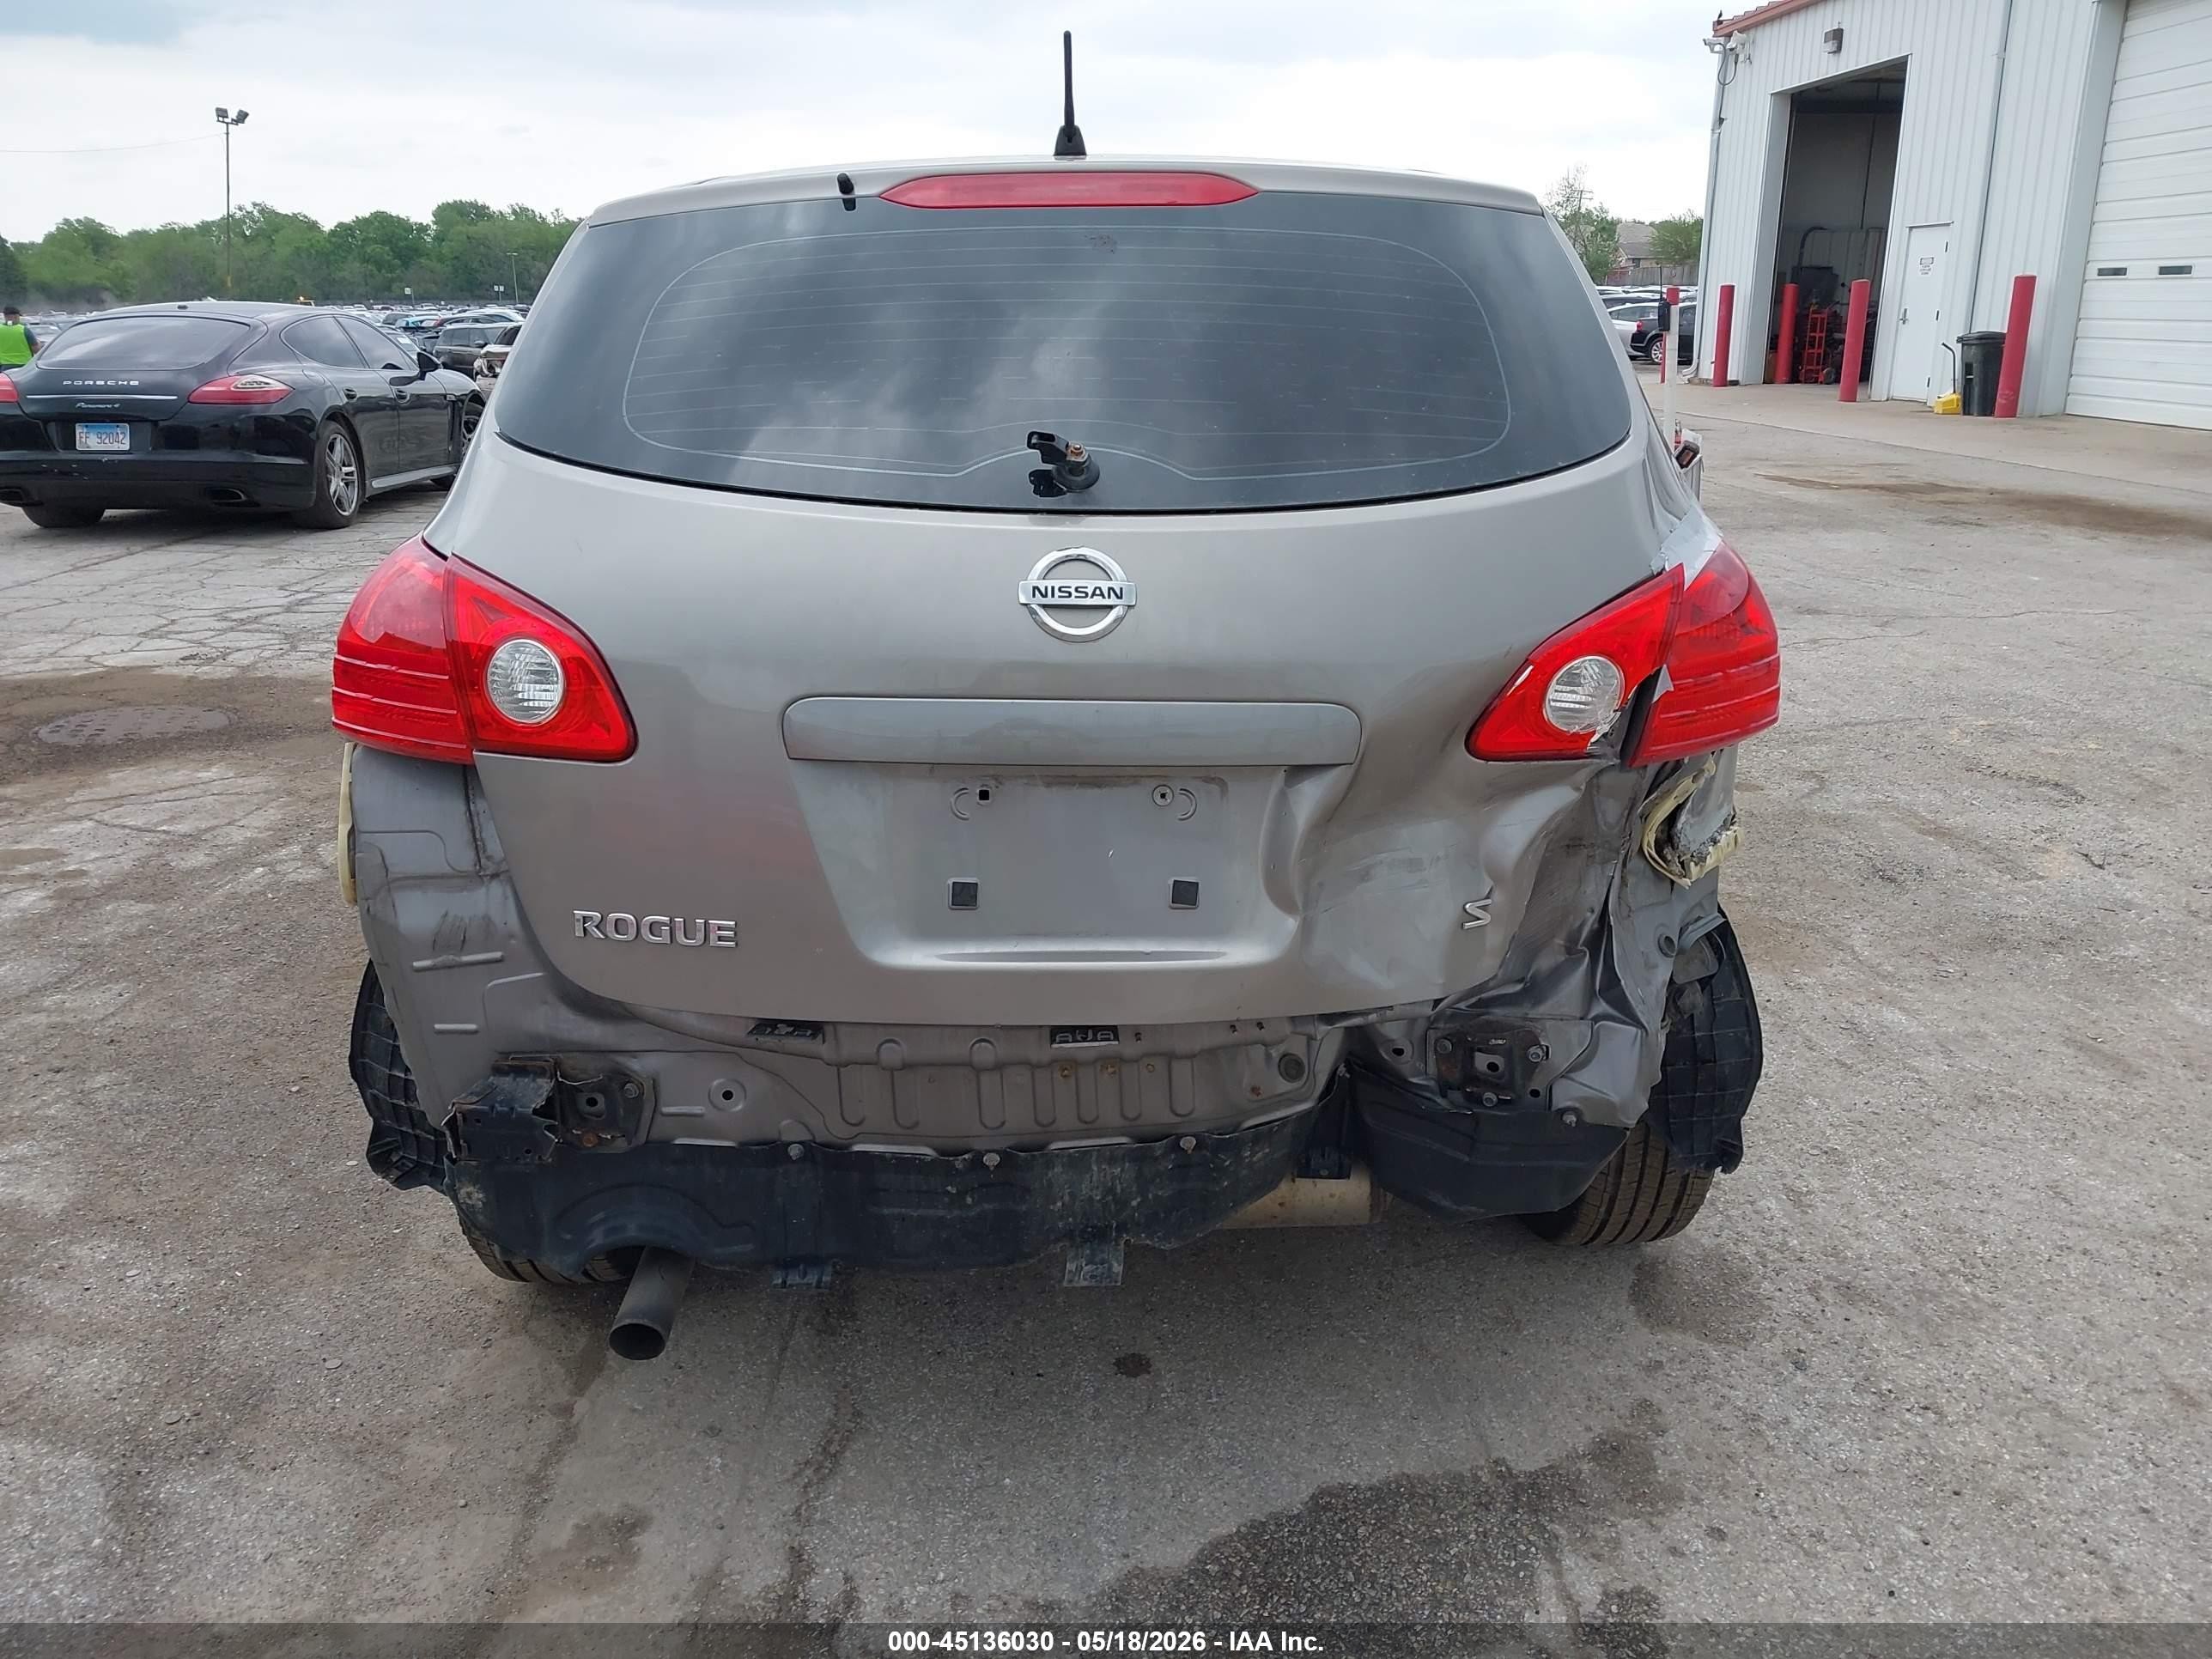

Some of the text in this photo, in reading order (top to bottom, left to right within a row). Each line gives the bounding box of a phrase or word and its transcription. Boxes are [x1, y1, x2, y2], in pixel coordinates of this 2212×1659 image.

[96, 431, 126, 445] 92042
[1031, 585, 1124, 600] NISSAN
[1462, 898, 1492, 929] S
[573, 910, 737, 948] ROGUE
